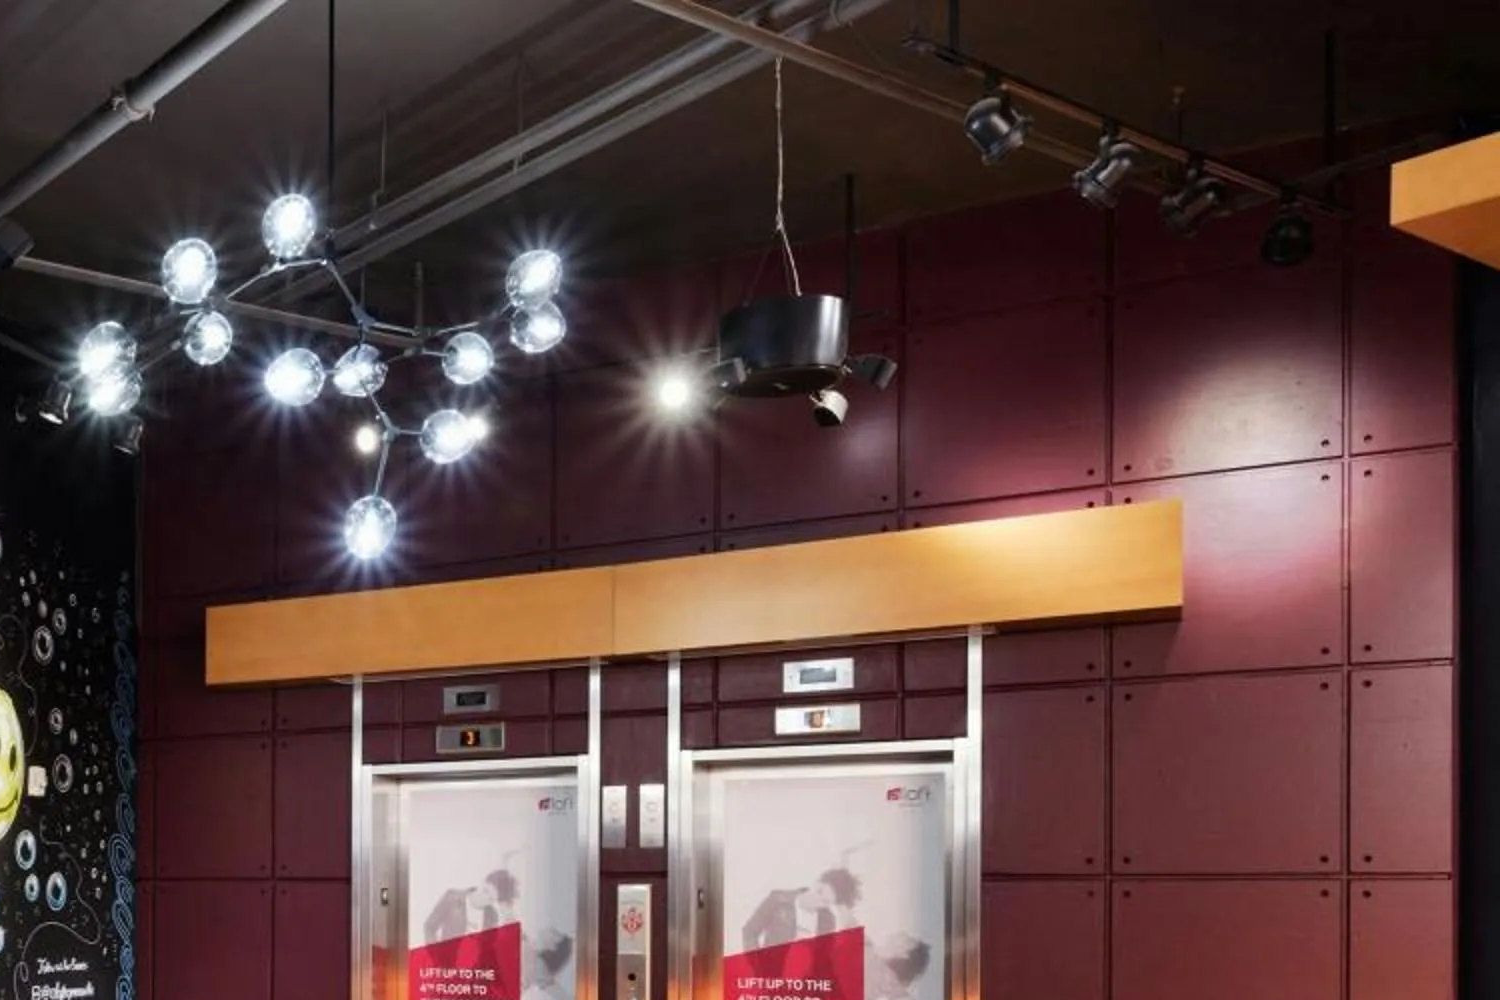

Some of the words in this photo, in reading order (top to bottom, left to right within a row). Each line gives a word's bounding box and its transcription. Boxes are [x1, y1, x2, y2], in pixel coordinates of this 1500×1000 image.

[420, 968, 441, 978] LIFT
[443, 968, 458, 979] UP
[460, 969, 473, 979] TO
[475, 969, 495, 980] THE
[436, 984, 471, 994] FLOOR
[473, 985, 487, 995] TO
[737, 978, 764, 989] LIFT
[766, 979, 784, 990] UP
[787, 979, 803, 990] TO
[806, 980, 832, 991] THE
